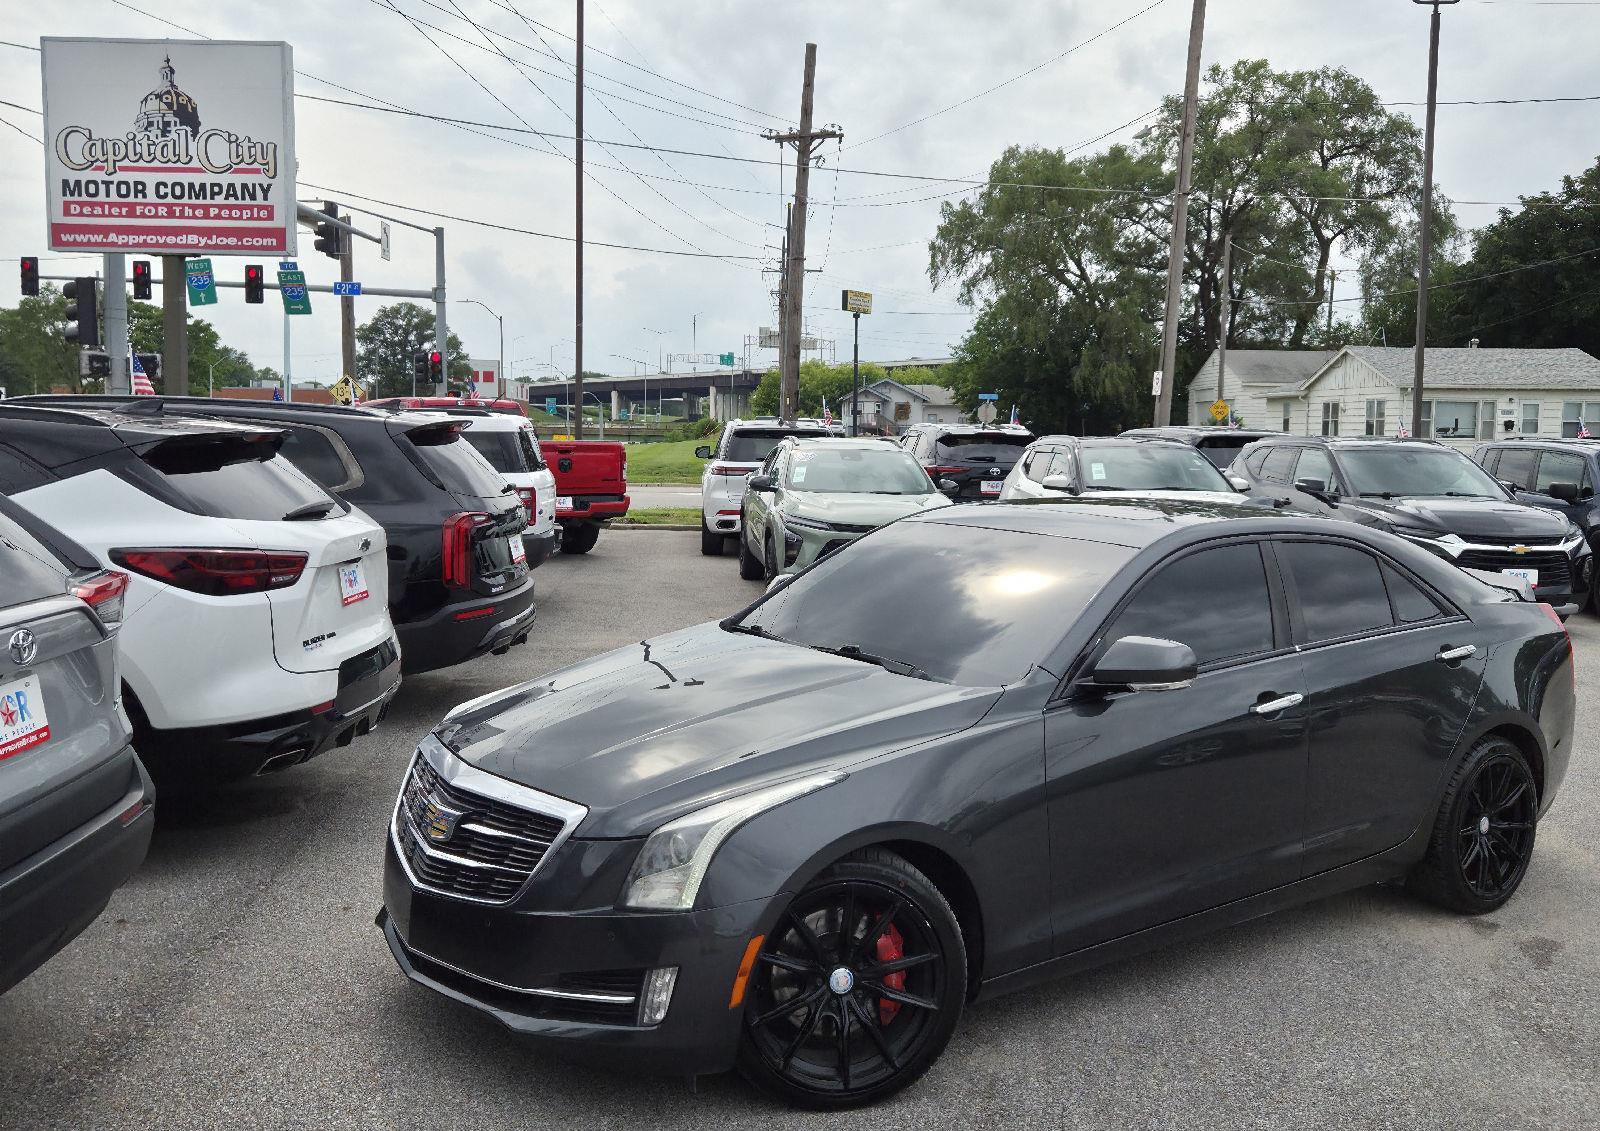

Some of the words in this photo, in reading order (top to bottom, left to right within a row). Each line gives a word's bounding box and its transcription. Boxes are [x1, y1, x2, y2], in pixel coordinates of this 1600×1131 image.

[56, 126, 193, 176] Capital
[197, 129, 278, 179] City
[62, 179, 147, 199] MOTOR
[155, 181, 273, 201] COMPANY
[70, 204, 128, 216] Dealer
[136, 205, 168, 217] FOR
[173, 206, 204, 218] The
[209, 207, 268, 219] People
[60, 233, 277, 247] www.ApprovedByJoe.com
[186, 261, 209, 270] WEST
[191, 276, 210, 286] 235
[280, 273, 302, 281] EAST
[285, 286, 304, 296] 235
